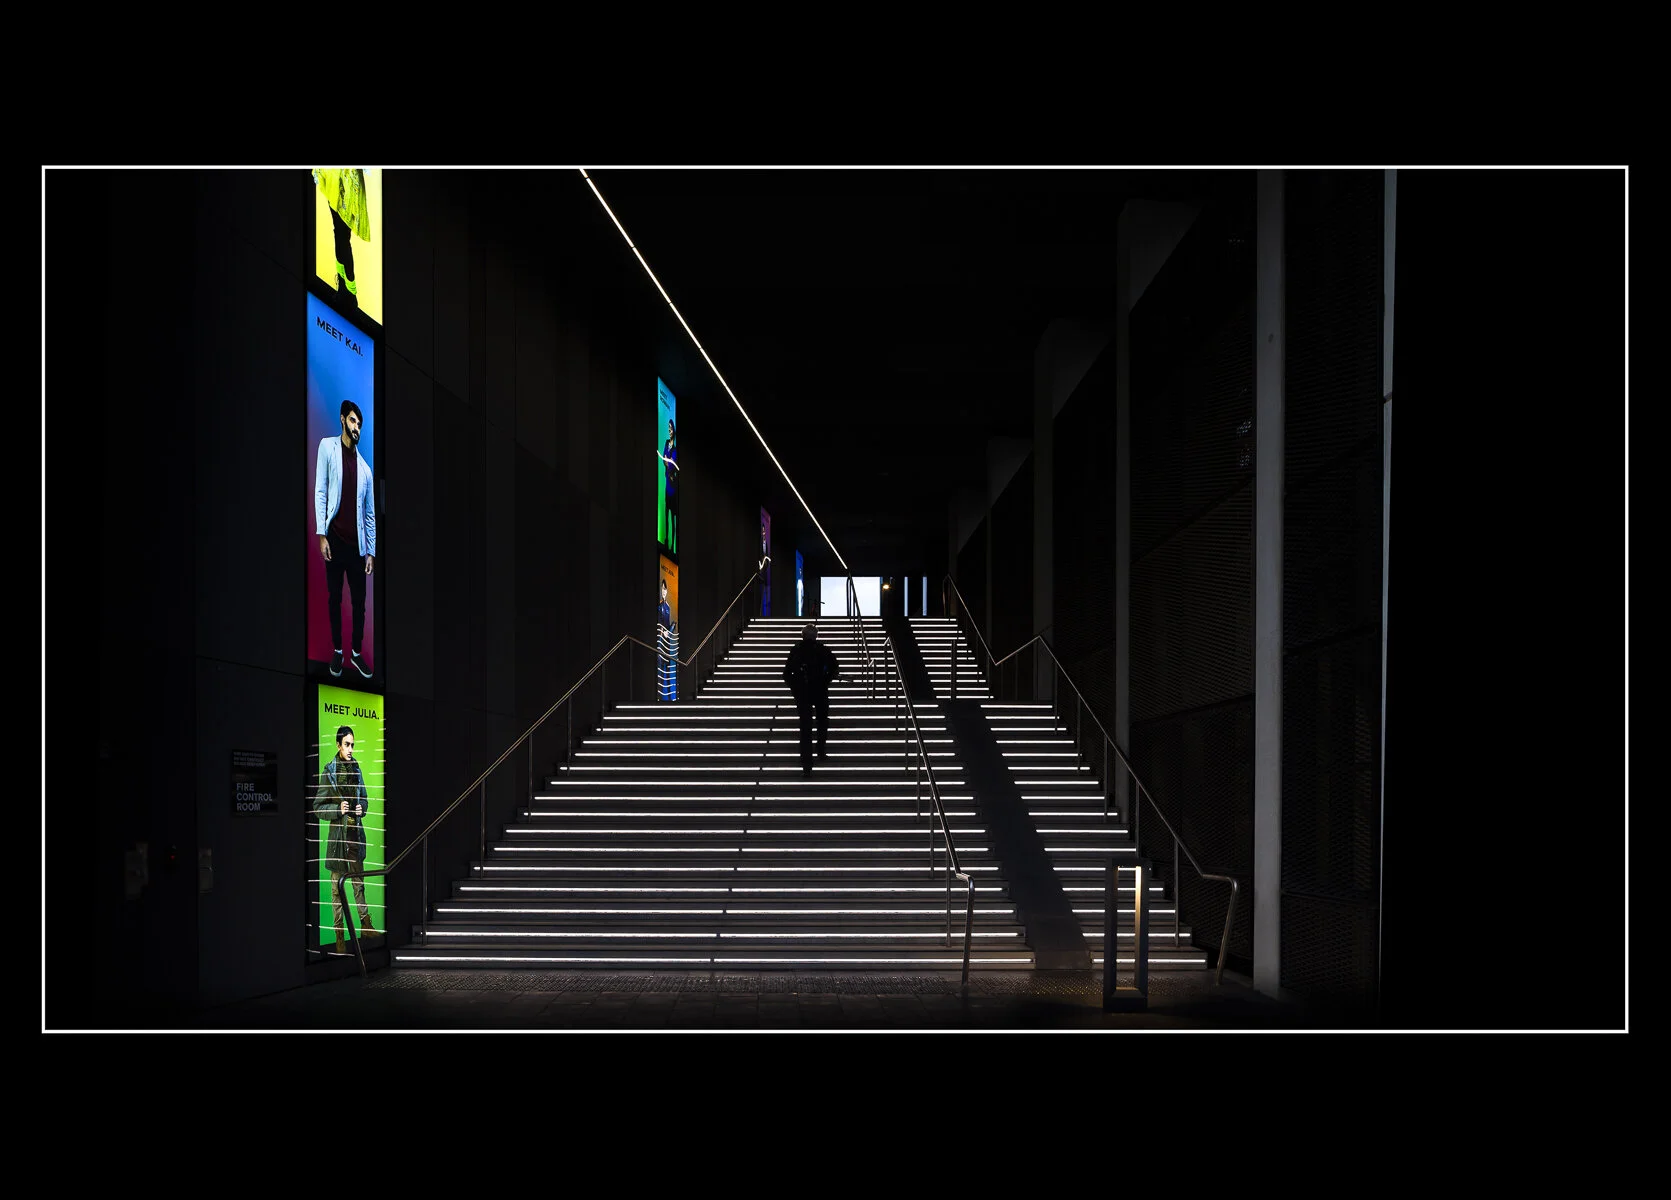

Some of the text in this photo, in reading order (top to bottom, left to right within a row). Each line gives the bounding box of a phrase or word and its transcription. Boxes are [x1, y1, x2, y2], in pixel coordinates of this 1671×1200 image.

[316, 316, 364, 357] MEET KAI.
[324, 702, 380, 720] MEET JULIA.
[236, 782, 255, 792] FIRE
[236, 792, 273, 802] CONTROL
[236, 802, 261, 812] ROOM
